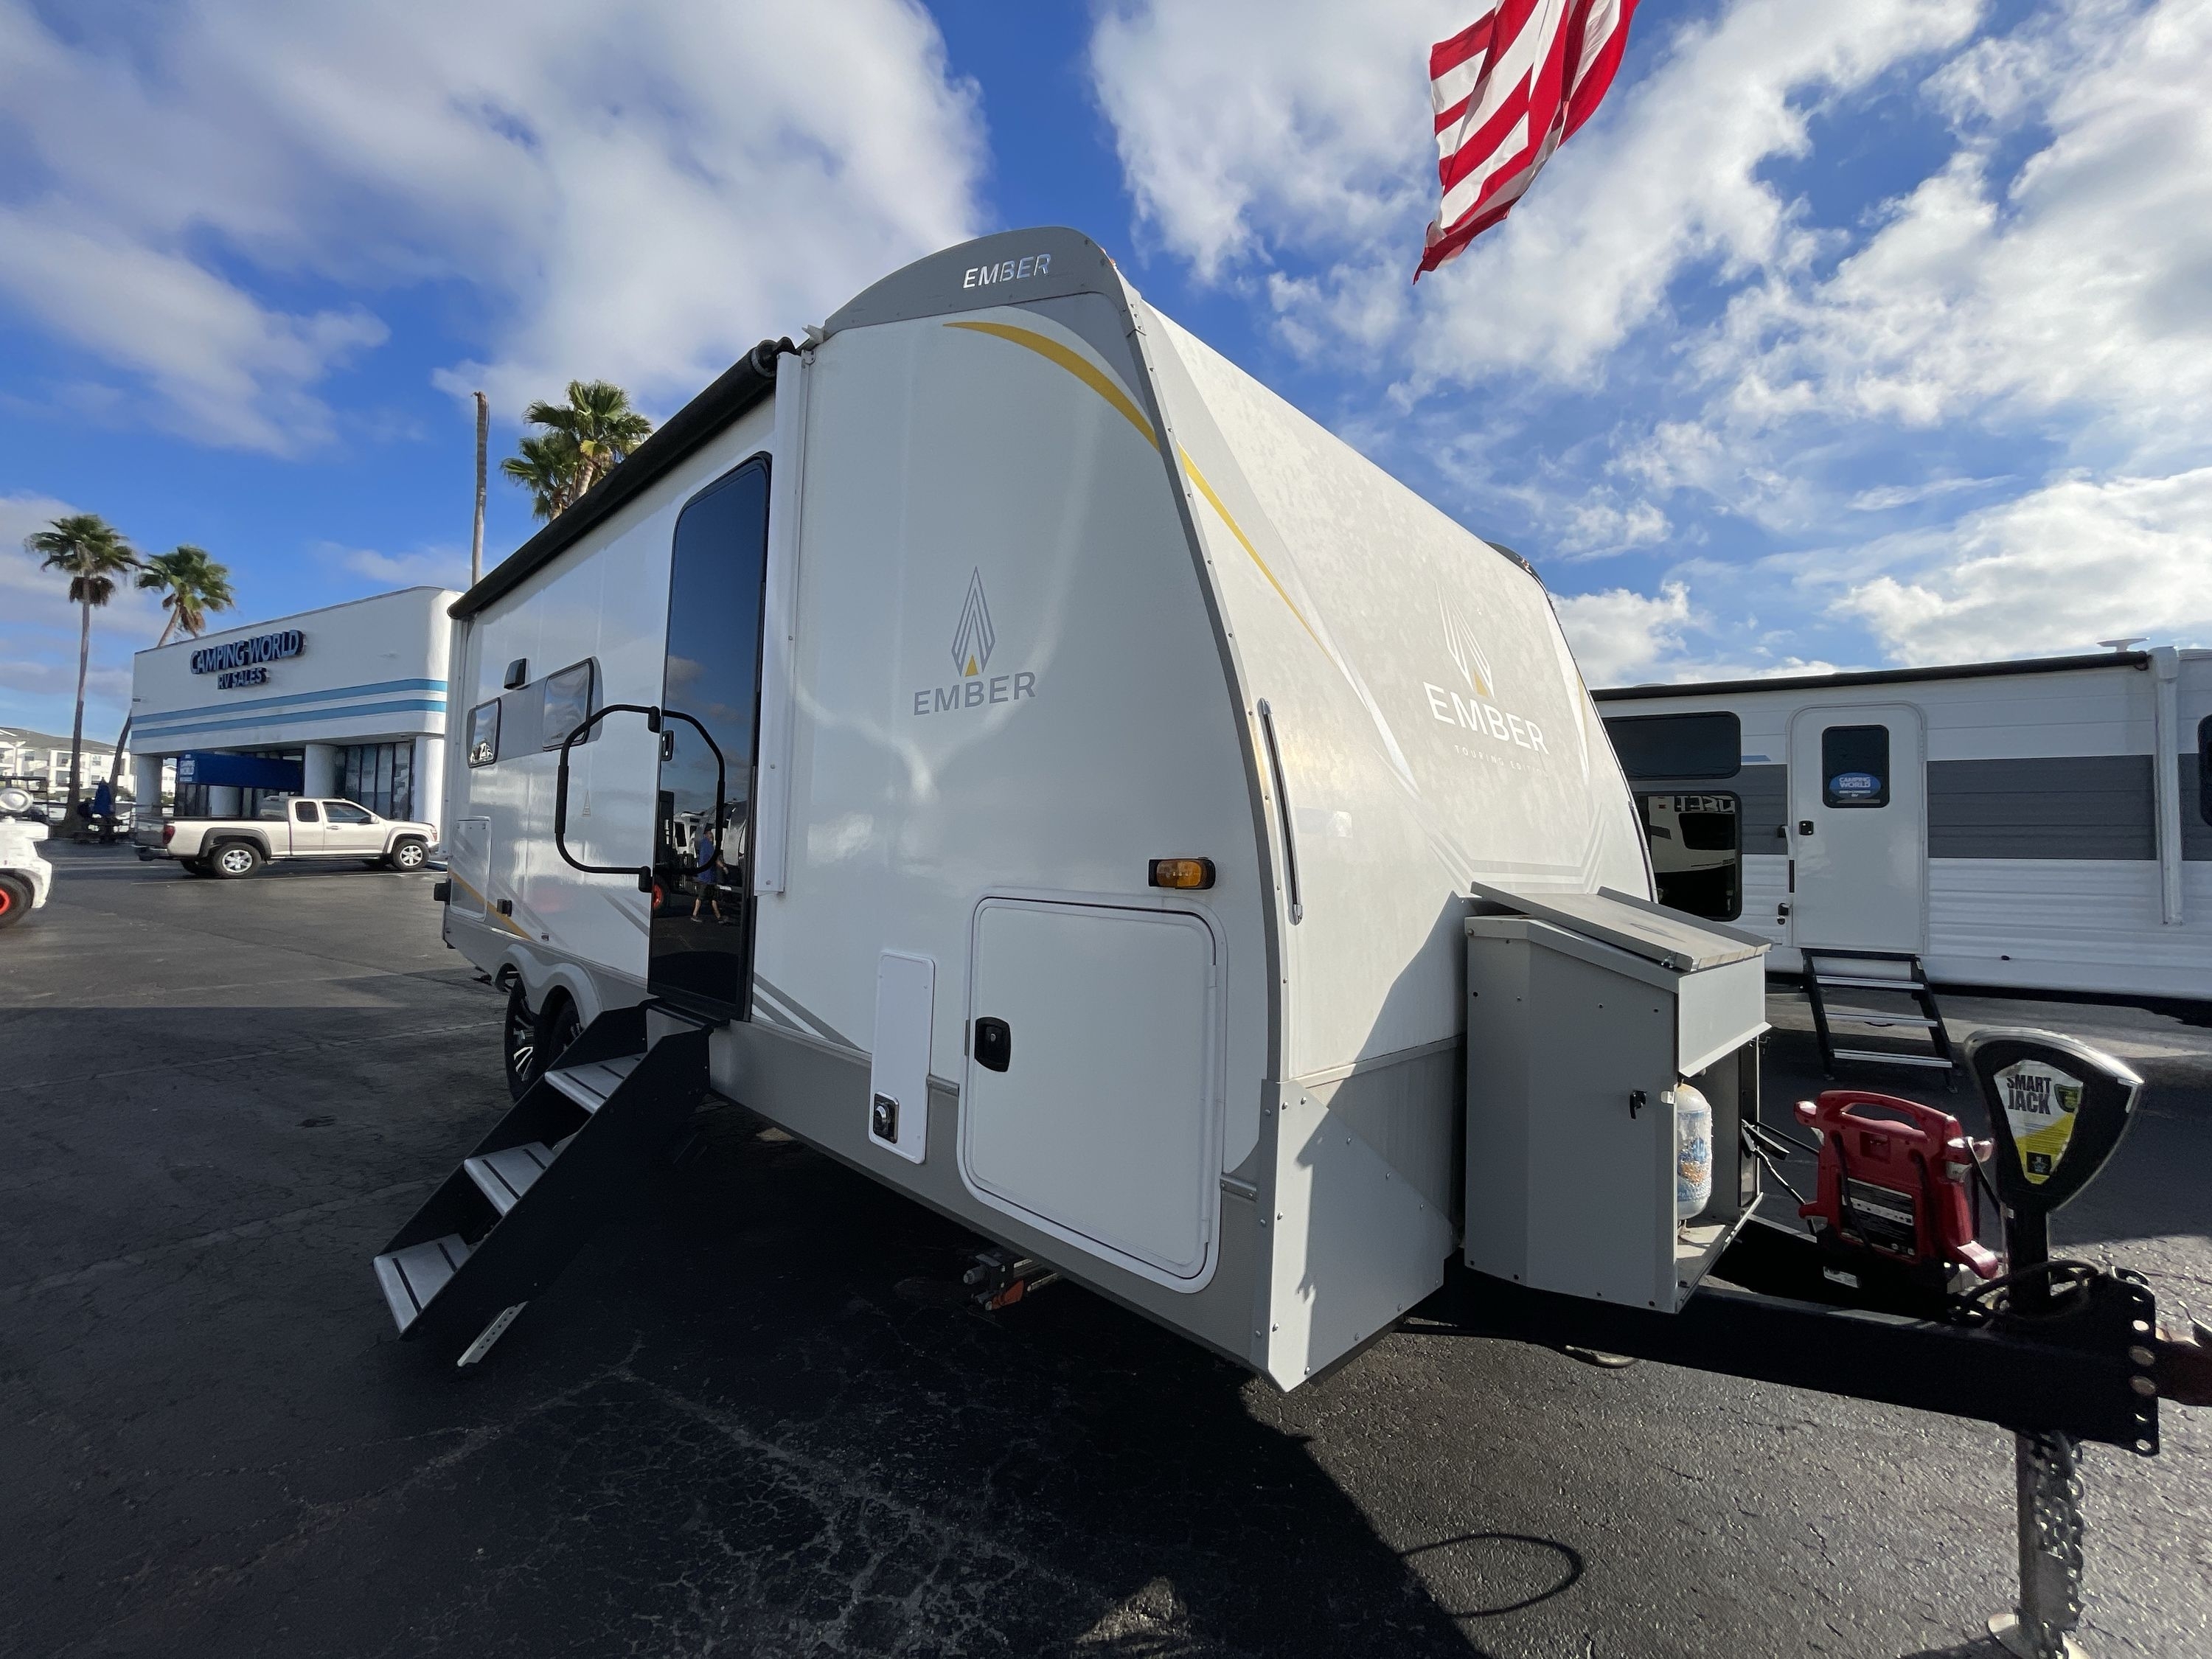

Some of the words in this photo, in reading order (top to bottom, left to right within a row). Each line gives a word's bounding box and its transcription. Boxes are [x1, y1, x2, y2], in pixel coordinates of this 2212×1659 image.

[962, 254, 1051, 289] EMBER
[190, 640, 246, 674] CAMPING
[248, 630, 302, 663] WORLD
[218, 672, 230, 689] RV
[232, 667, 265, 688] SALES
[914, 672, 1036, 715] EMBER
[1422, 681, 1550, 755] EMBER
[1454, 745, 1505, 766] TOURING
[2006, 1074, 2052, 1093] SMART
[2008, 1088, 2051, 1115] JACK
